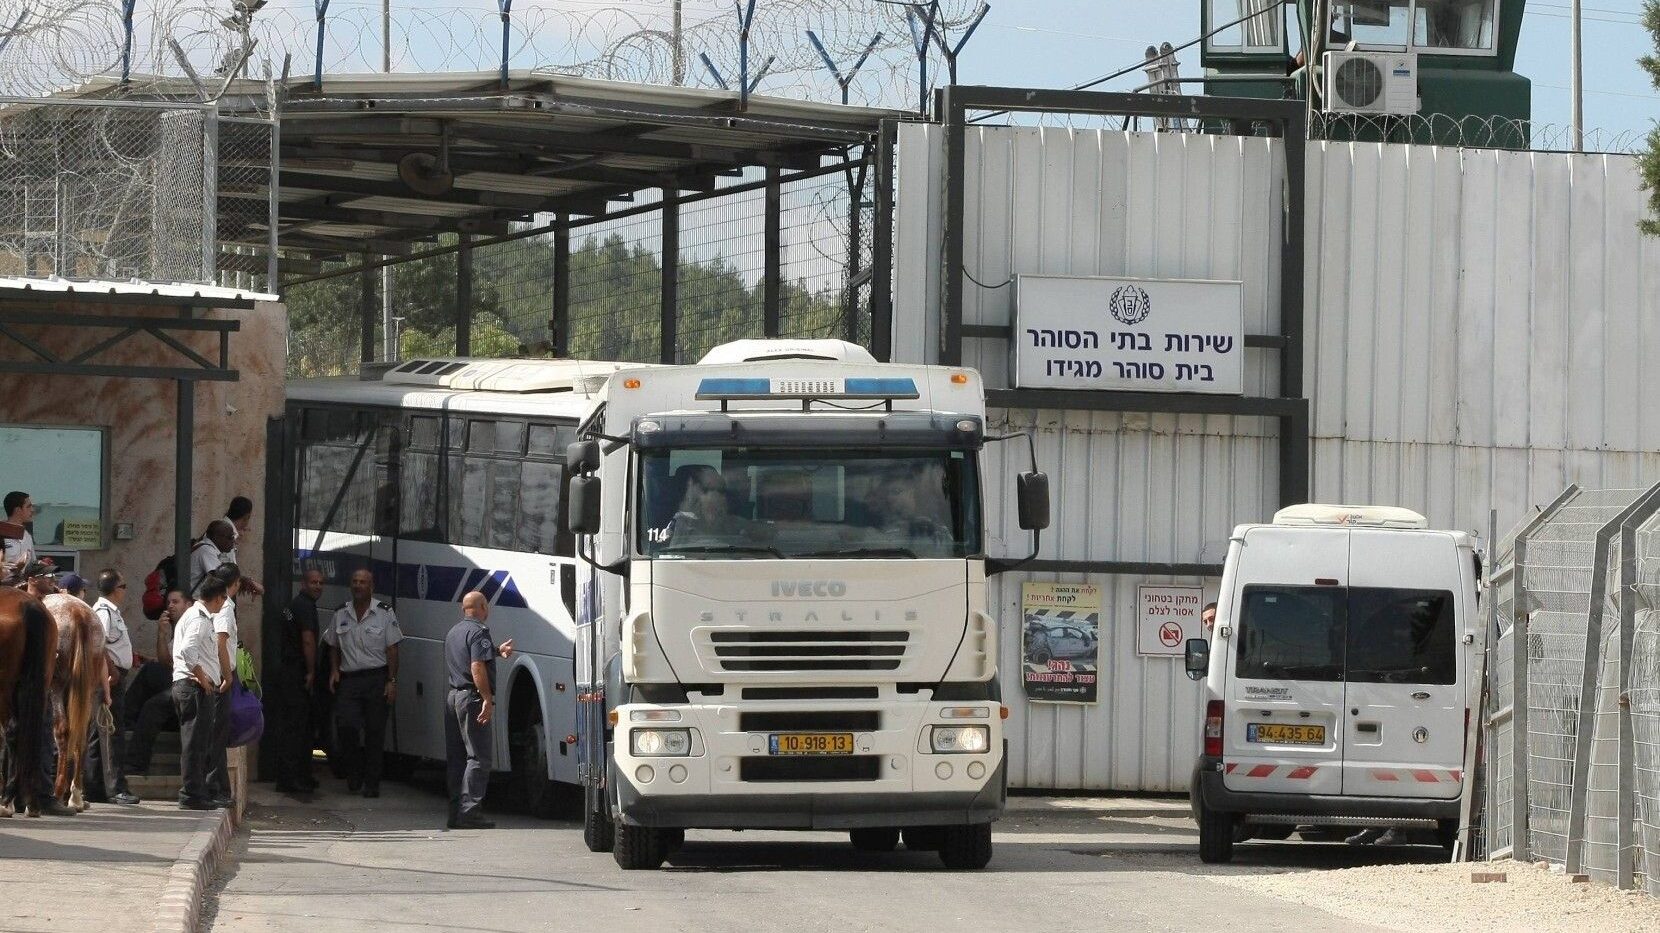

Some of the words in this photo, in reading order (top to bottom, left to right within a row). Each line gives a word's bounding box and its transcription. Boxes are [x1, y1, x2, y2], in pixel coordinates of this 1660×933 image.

[1027, 329, 1099, 349] הסוהר
[1110, 331, 1152, 351] בתי
[1164, 333, 1233, 353] שירות
[1046, 359, 1102, 378] מגידו
[1112, 360, 1164, 380] סוהר
[1175, 362, 1214, 381] בית
[647, 527, 669, 542] 114
[770, 580, 847, 597] IVECO
[1057, 594, 1076, 604] לקחת
[1144, 594, 1172, 603] בטחוני
[1175, 595, 1198, 606] מתקן
[700, 609, 918, 622] STRALIS
[1149, 605, 1170, 615] לצלם
[1173, 607, 1194, 616] אסור
[1245, 686, 1289, 695] TRANSIT
